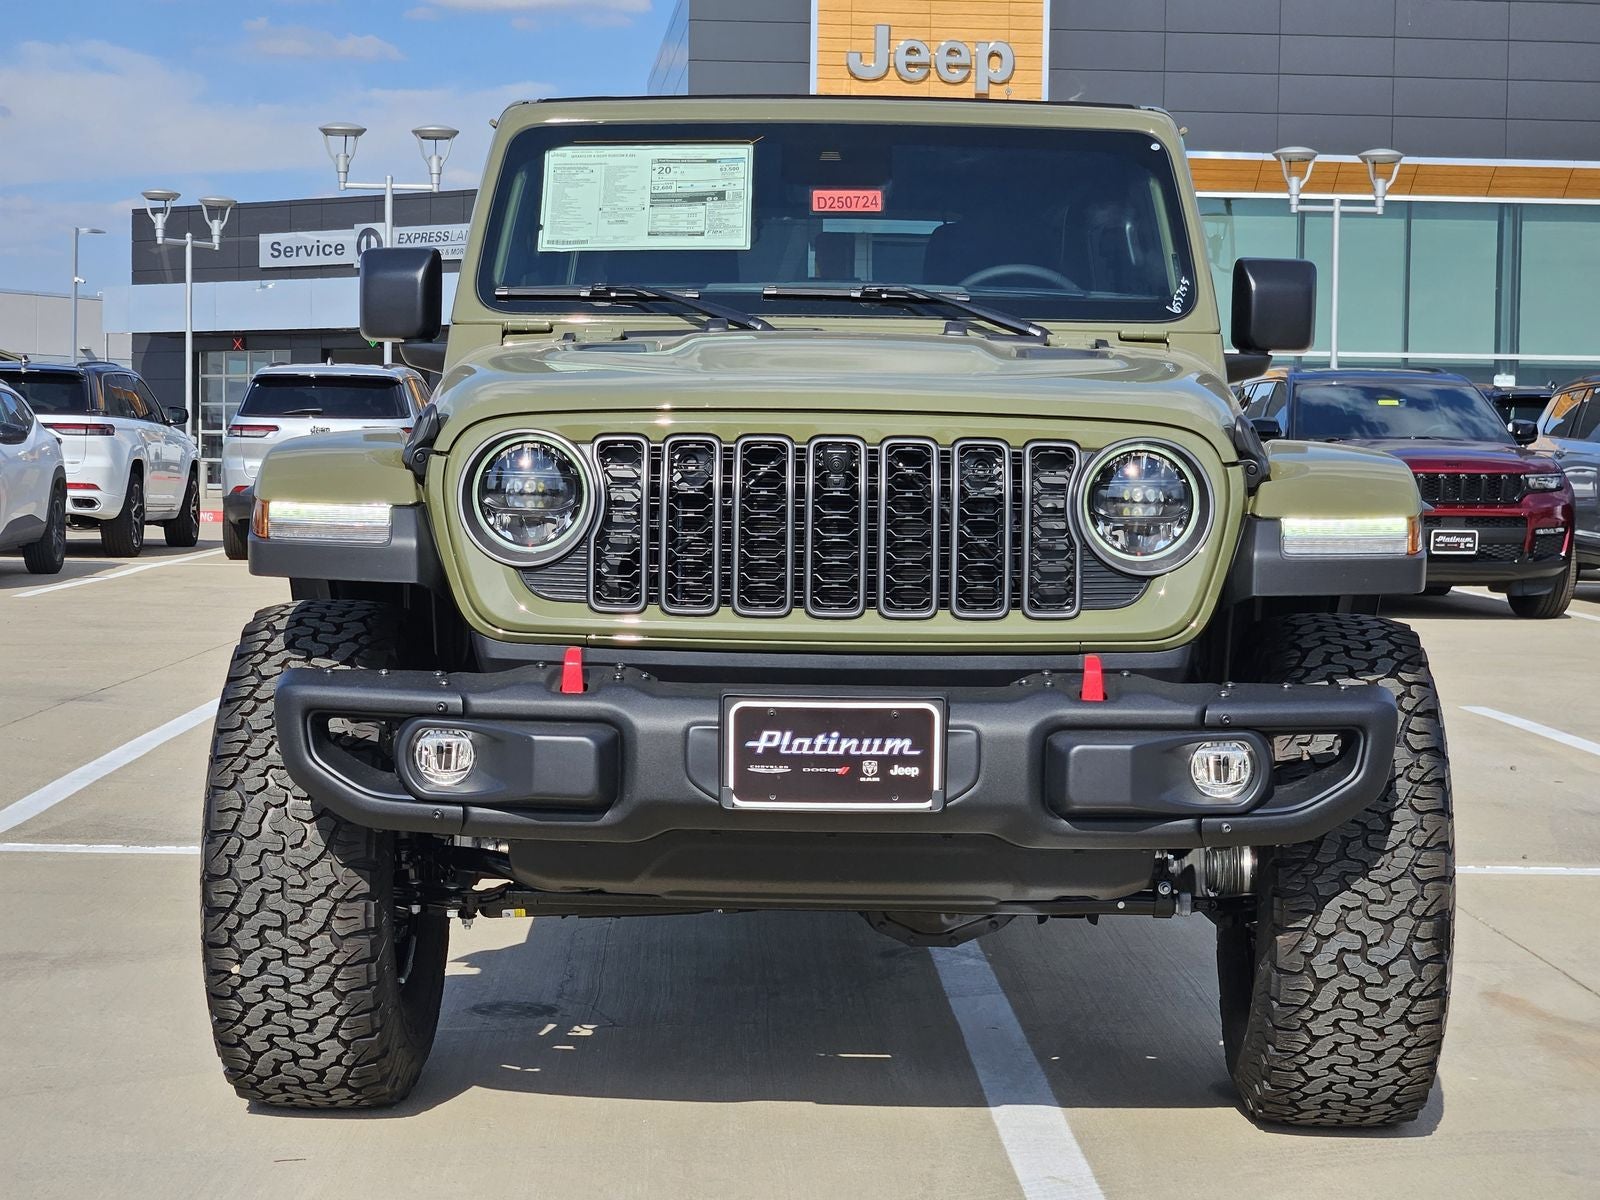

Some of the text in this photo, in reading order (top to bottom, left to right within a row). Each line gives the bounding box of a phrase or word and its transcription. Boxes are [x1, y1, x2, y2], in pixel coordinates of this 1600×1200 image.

[847, 24, 1015, 99] Jeep
[657, 166, 672, 174] 20
[817, 195, 878, 209] D250724
[270, 239, 345, 259] Service
[745, 730, 924, 755] Platinum
[890, 764, 920, 777] Jeep
